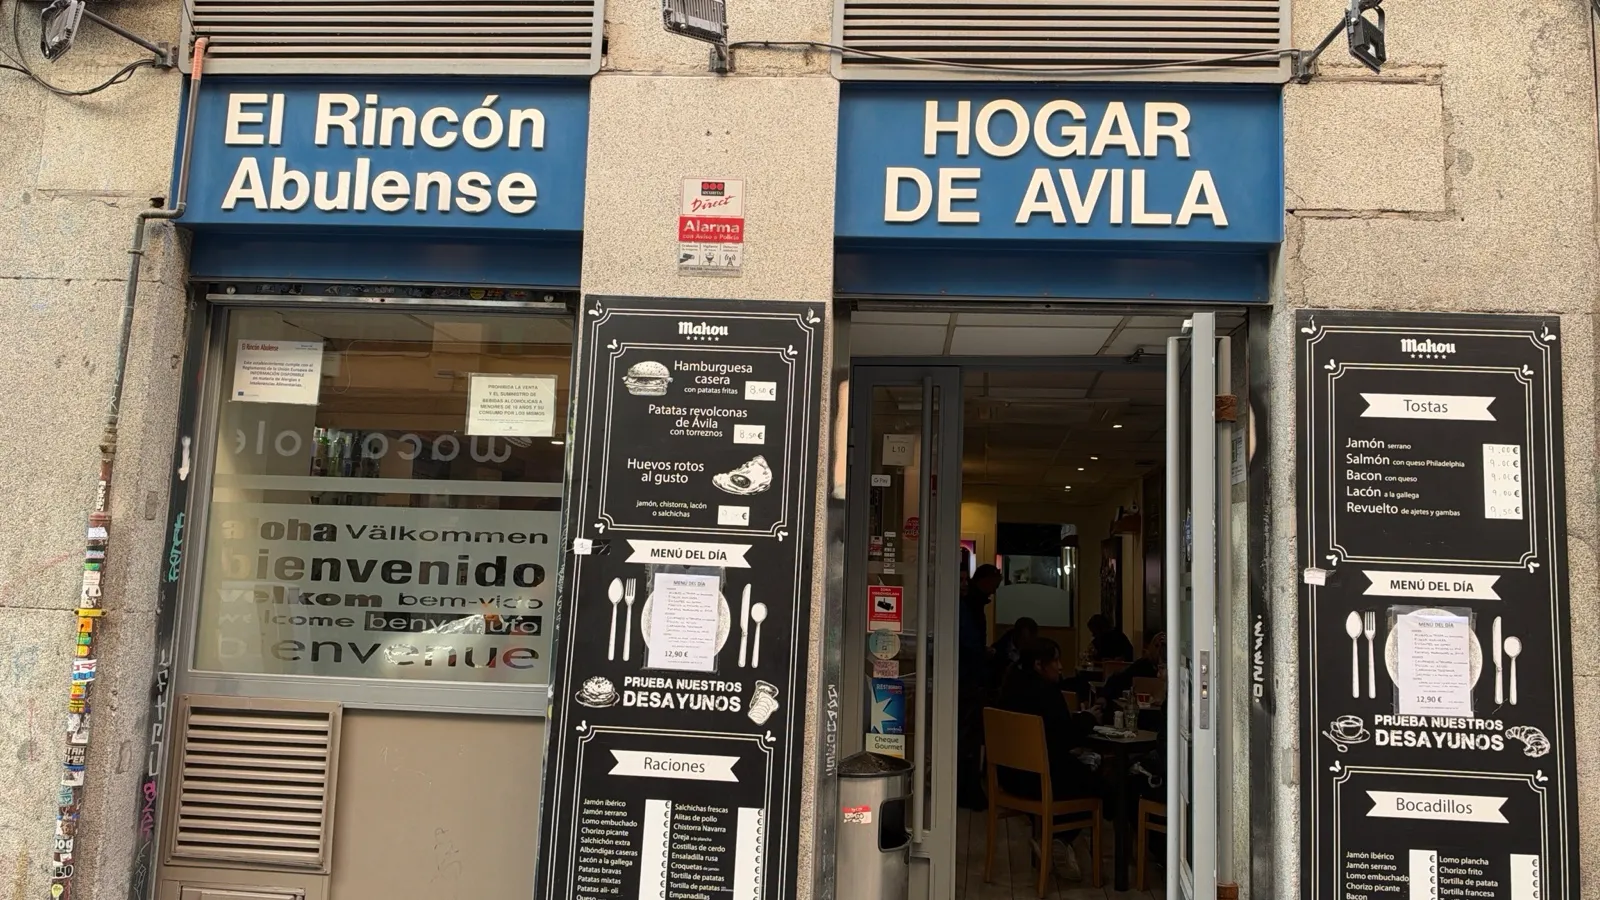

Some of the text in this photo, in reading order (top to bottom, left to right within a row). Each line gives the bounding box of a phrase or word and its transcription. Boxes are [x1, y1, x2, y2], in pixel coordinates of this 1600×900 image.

[224, 92, 545, 150] El Rincón
[923, 98, 1191, 158] HOGAR
[220, 156, 538, 215] Abulense
[883, 166, 1229, 226] DE AVILA
[691, 196, 736, 212] Direct
[683, 220, 740, 233] Alarma
[678, 322, 728, 336] Mahou
[1401, 339, 1456, 353] Mahou
[674, 360, 753, 374] Hamburguesa
[695, 374, 730, 385] casera
[649, 405, 748, 418] Patatas revolconas
[1403, 399, 1448, 413] Tostas
[676, 415, 718, 428] de Ávila
[686, 429, 723, 438] torreznos
[1346, 437, 1385, 448] Jamón
[628, 458, 704, 472] Huevos rotos
[1346, 453, 1390, 465] Salmón
[1426, 459, 1465, 468] Philadelphia
[641, 472, 689, 484] al gusto
[1346, 470, 1382, 481] Bacon
[1346, 486, 1381, 497] Lacón
[1346, 502, 1398, 514] Revuelto
[346, 524, 548, 544] Välkommen
[650, 547, 727, 560] MENÚ DEL DÍA
[222, 548, 546, 588] bienvenido
[1390, 578, 1474, 592] MENÚ DEL DÍA
[368, 612, 539, 634] benvuto
[624, 676, 742, 692] PRUEBA NUESTROS
[623, 690, 741, 712] DESAYUNOS
[1374, 714, 1503, 731] PRUEBA NUESTROS
[1375, 730, 1504, 751] DESAYUNOS
[644, 756, 705, 773] Raciones
[675, 804, 706, 812] Salchichas
[1396, 797, 1473, 814] Bocadillos
[601, 818, 638, 827] embuchado
[702, 815, 717, 824] pollo
[673, 833, 690, 841] Oreja
[580, 846, 614, 855] Albóndigas
[672, 842, 697, 850] Costillas
[610, 858, 632, 866] gallega
[672, 852, 704, 861] Ensaladilla
[1371, 852, 1394, 860] ibérico
[1461, 857, 1489, 865] plancha
[671, 862, 702, 870] Croquetas
[670, 871, 691, 879] Tortilla
[1368, 873, 1410, 882] embuchado
[1440, 877, 1464, 885] Tortilla
[1476, 879, 1498, 887] patata
[669, 891, 710, 900] Empanadillas
[1440, 887, 1494, 897] Tortilla francesa
